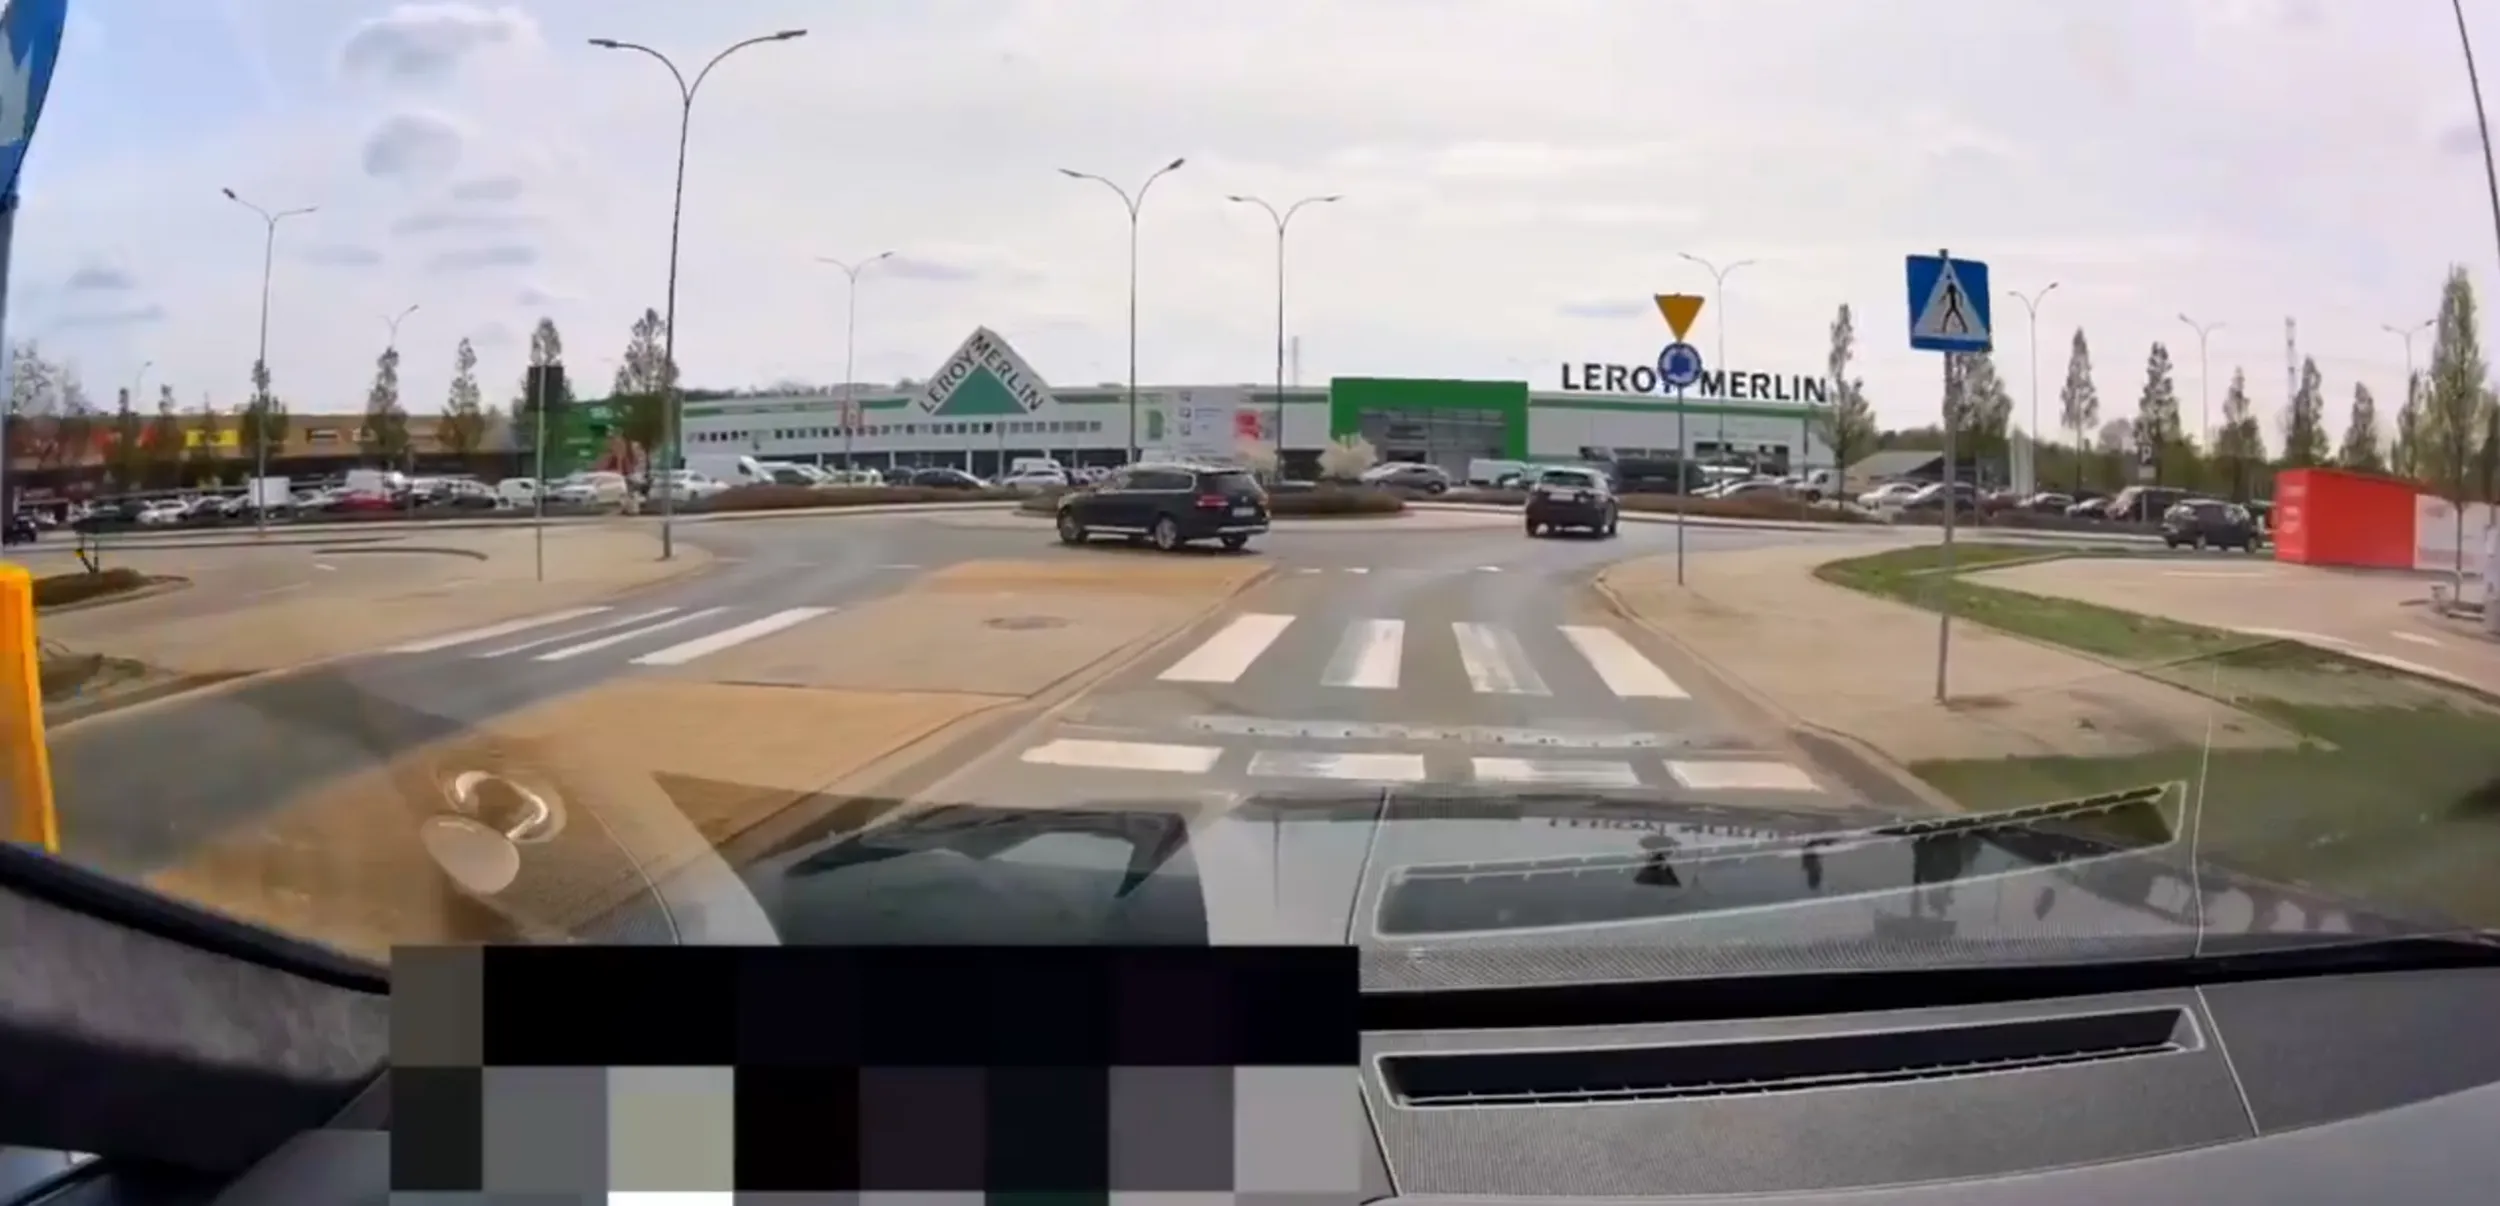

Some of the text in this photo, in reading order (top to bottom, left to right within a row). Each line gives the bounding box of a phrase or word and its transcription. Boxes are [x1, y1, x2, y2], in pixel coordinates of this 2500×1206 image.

[919, 335, 1044, 414] LEROY MERLIN
[1700, 370, 1826, 403] MERLIN
